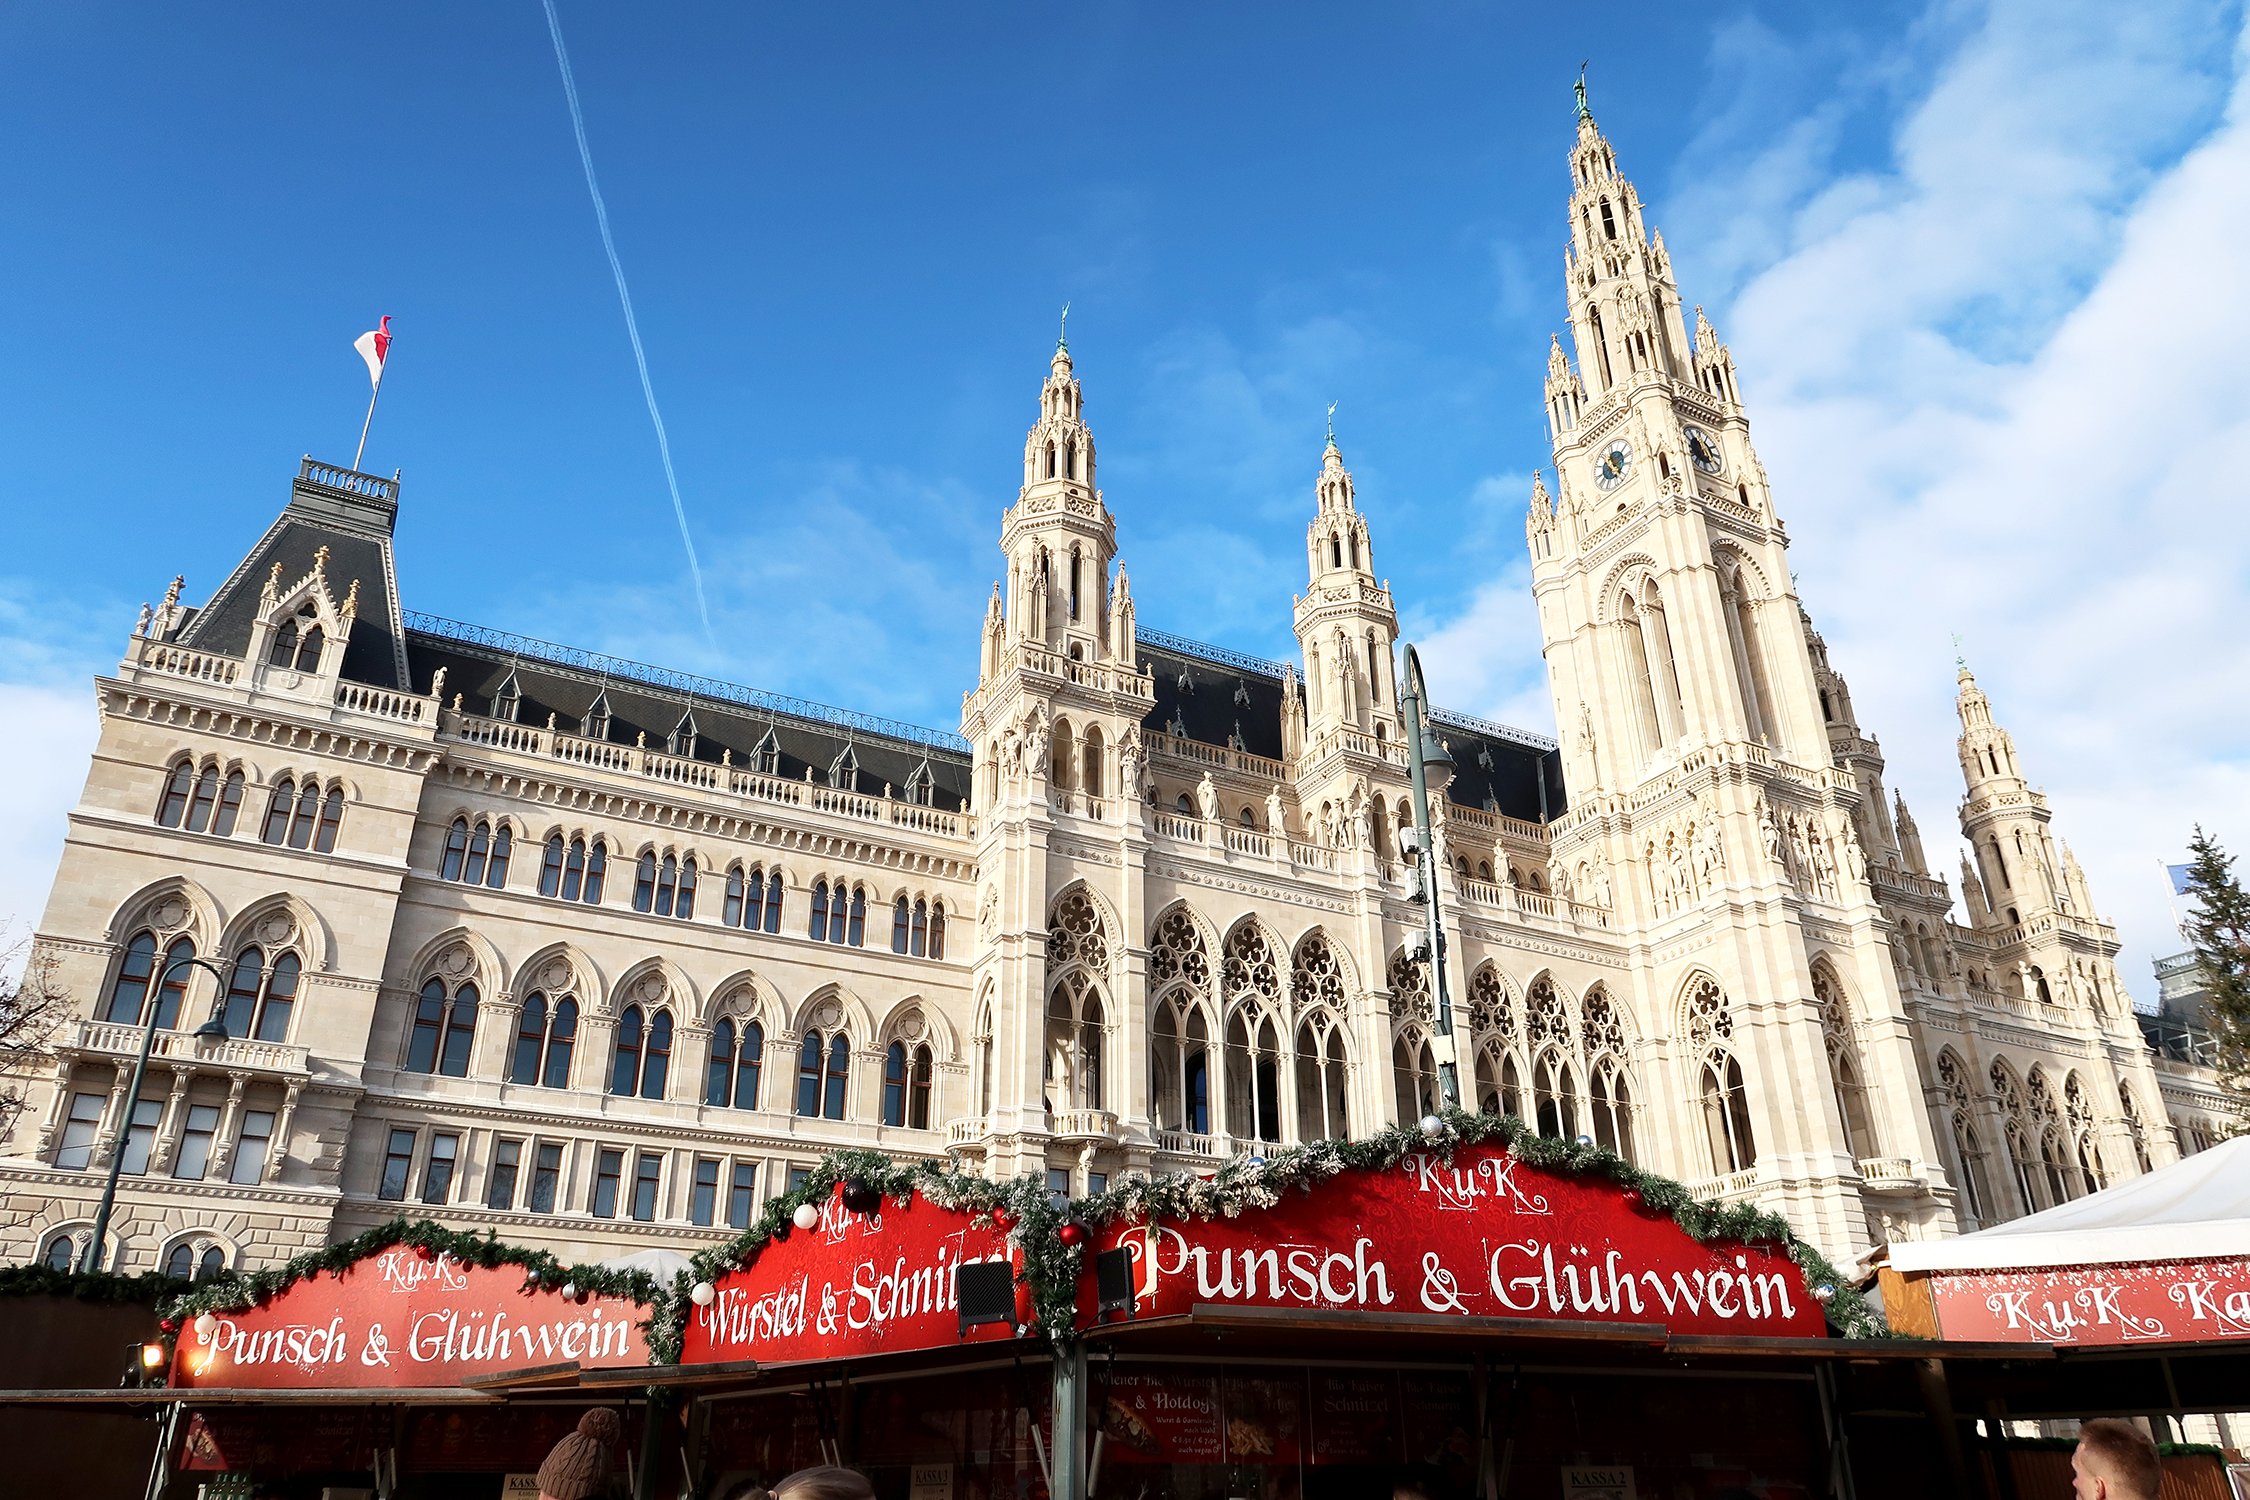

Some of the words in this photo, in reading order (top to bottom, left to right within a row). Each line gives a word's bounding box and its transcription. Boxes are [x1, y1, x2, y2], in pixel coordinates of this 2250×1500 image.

[699, 1273, 809, 1346] Würstel
[816, 1281, 838, 1335] &
[847, 1234, 1014, 1330] Schnit
[1116, 1226, 1395, 1312] Punsch
[1419, 1251, 1469, 1315] &
[1490, 1238, 1796, 1319] Glühwein
[194, 1314, 348, 1377] Punsch
[361, 1323, 392, 1367] &
[408, 1308, 631, 1364] Glühwein
[1135, 1393, 1148, 1410] &
[1152, 1392, 1217, 1414] Hotdogs
[510, 1477, 538, 1488] KASS
[1571, 1471, 1616, 1485] KASSA
[1619, 1471, 1626, 1484] 2
